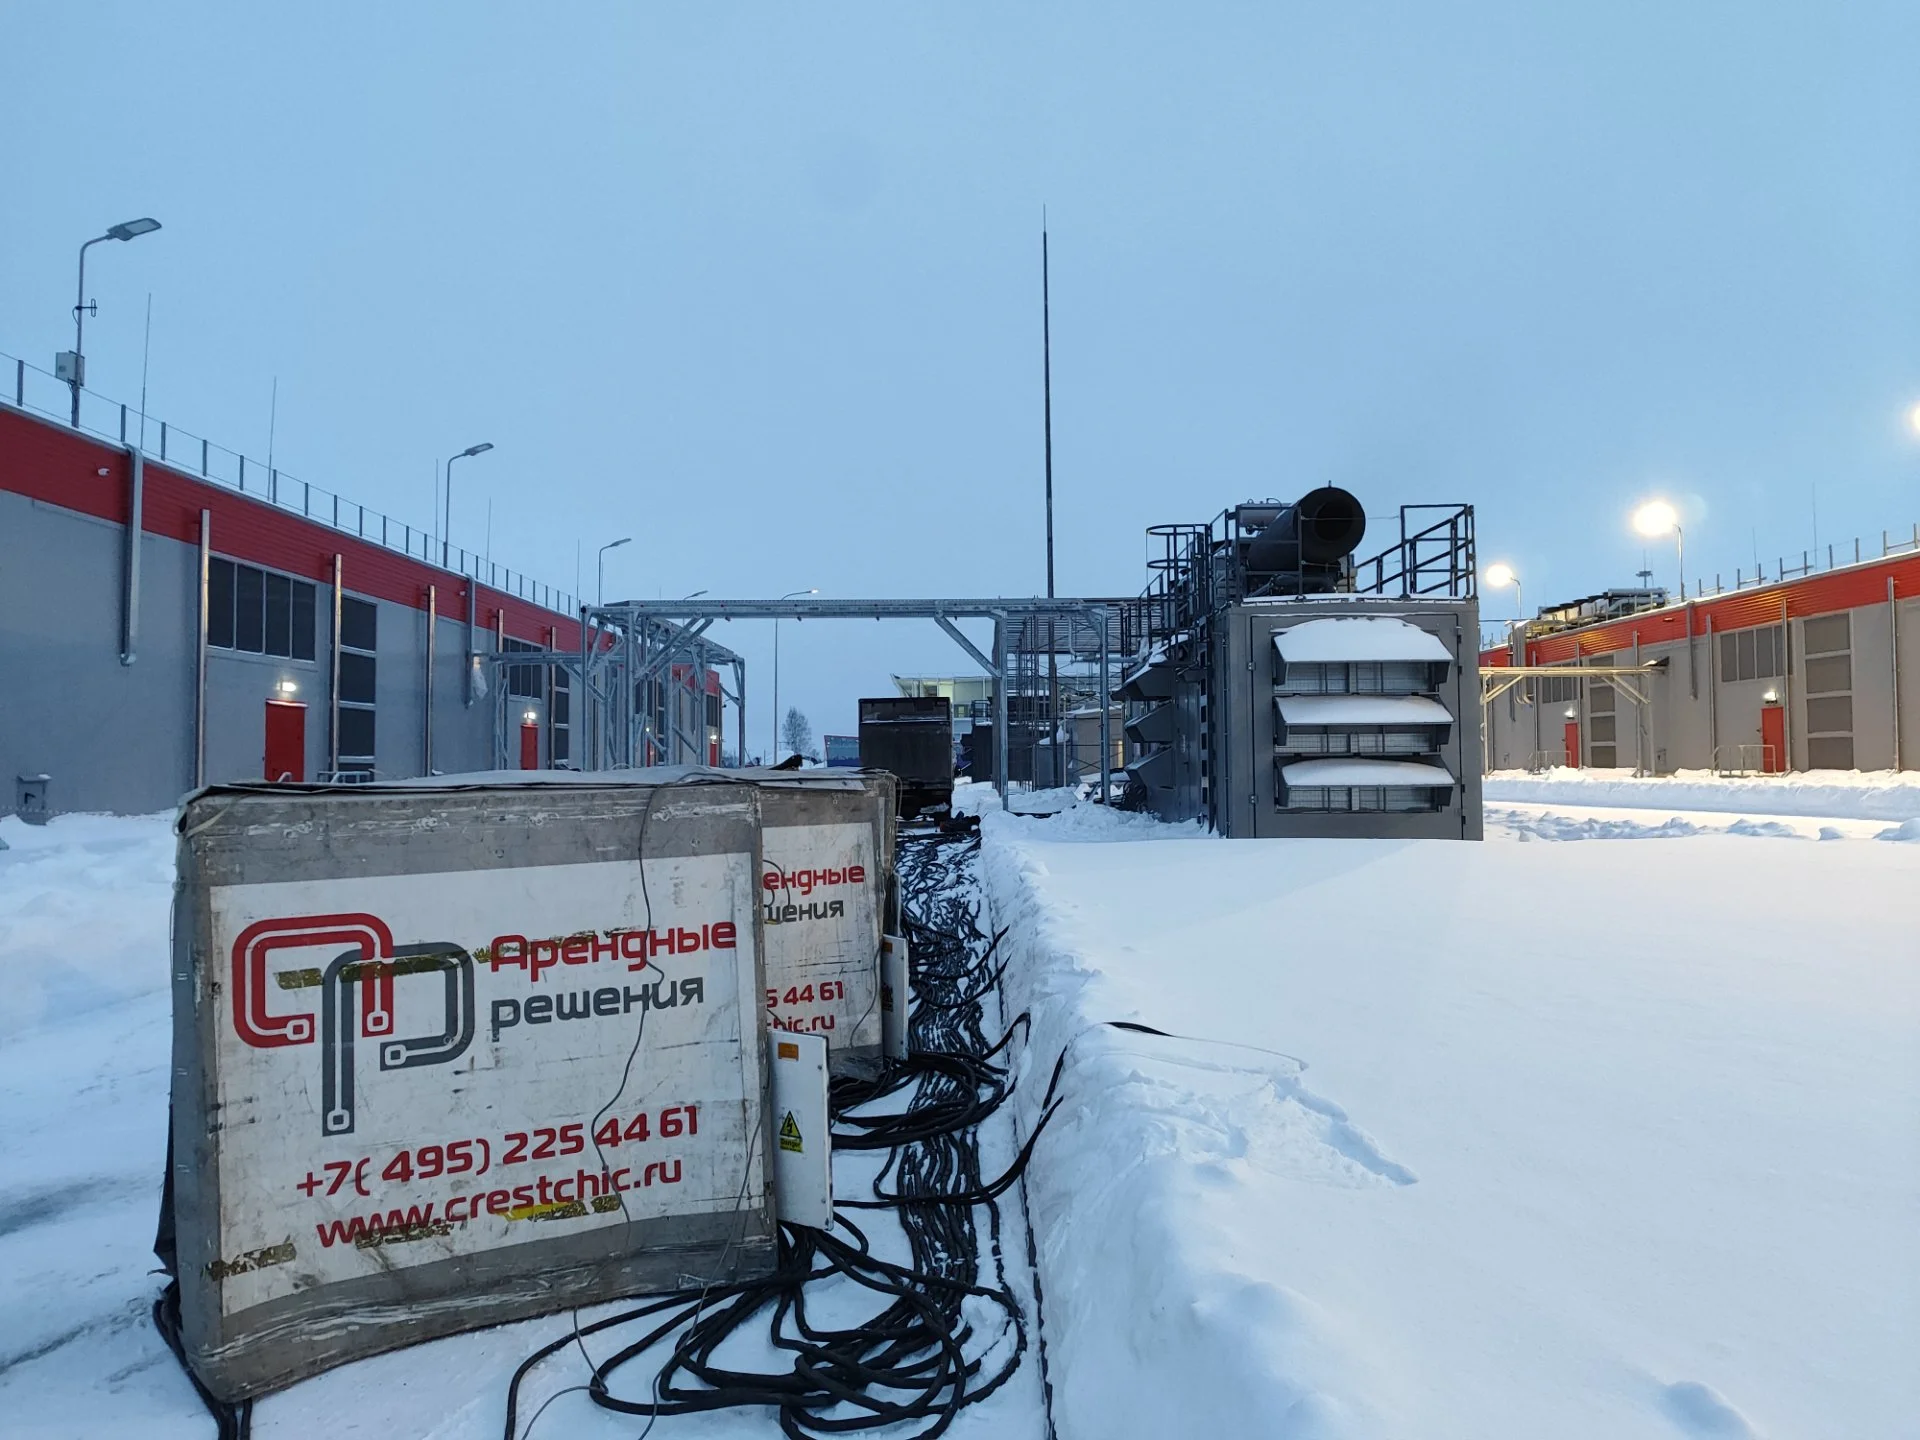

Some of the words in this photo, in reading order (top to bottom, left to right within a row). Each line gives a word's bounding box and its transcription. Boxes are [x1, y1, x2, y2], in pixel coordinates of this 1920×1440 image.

[491, 921, 736, 982] Арендные
[491, 976, 704, 1043] решения
[767, 1011, 835, 1033] hic.ru
[783, 984, 814, 1005] 44
[820, 980, 844, 1001] 61
[502, 1123, 584, 1165] 225
[595, 1112, 650, 1148] 44
[659, 1104, 698, 1138] 61
[316, 1159, 682, 1248] www.crestchic.ru
